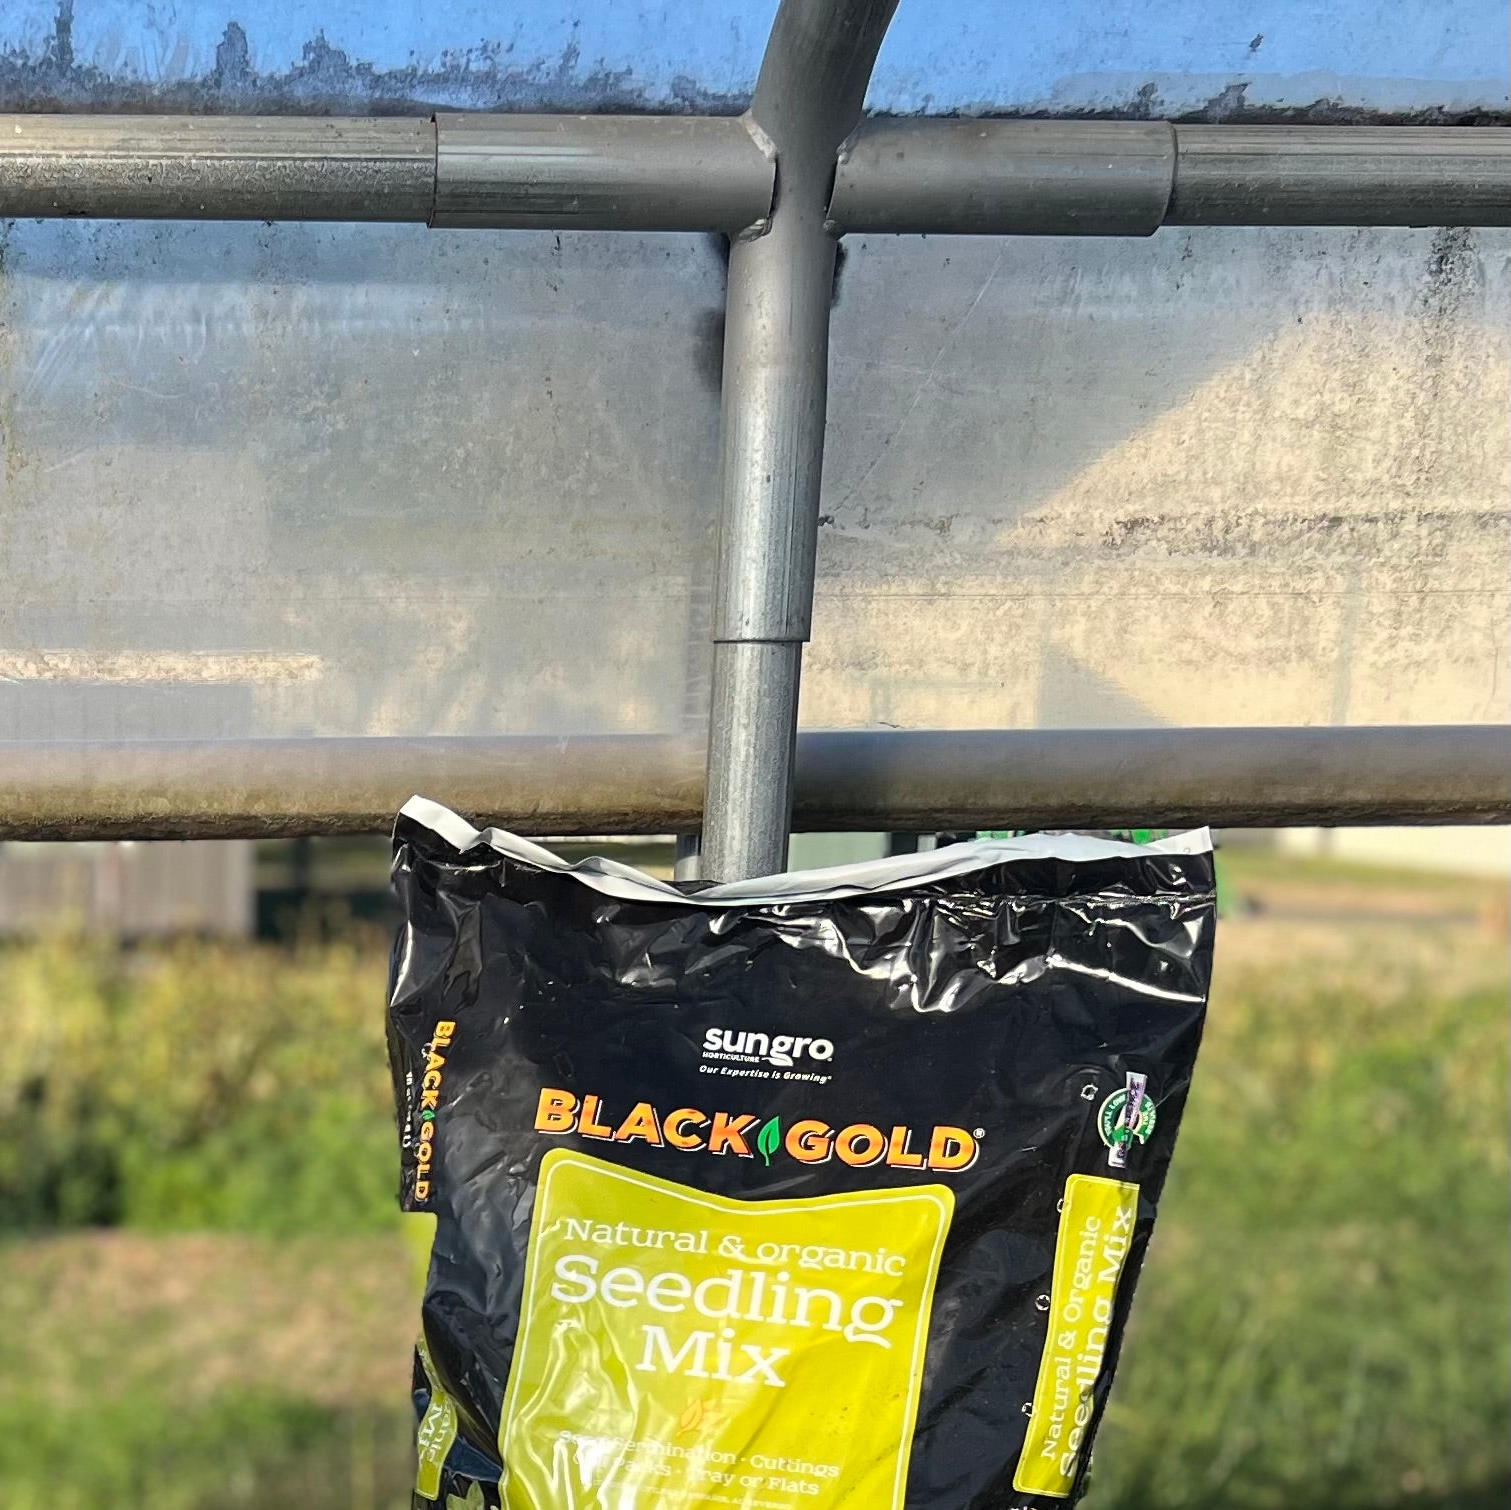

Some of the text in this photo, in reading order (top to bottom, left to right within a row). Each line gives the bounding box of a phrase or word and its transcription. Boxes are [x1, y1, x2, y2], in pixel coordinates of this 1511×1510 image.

[699, 1065, 718, 1074] Our
[720, 1067, 770, 1079] Expertise
[771, 1069, 781, 1080] is
[702, 1027, 834, 1066] sungro
[702, 1051, 760, 1063] HORTICULTURE
[415, 1021, 457, 1202] BLACK GOLD
[533, 1086, 981, 1173] BLACK GOLD
[562, 1218, 906, 1277] Natural & organic
[1098, 1207, 1133, 1283] Mix
[550, 1254, 904, 1349] Seedling
[635, 1324, 790, 1388] Mix
[1041, 1216, 1101, 1460] Natural & Organic
[739, 1474, 763, 1488] or
[769, 1477, 820, 1495] Flats
[749, 1453, 840, 1478] Cuttings
